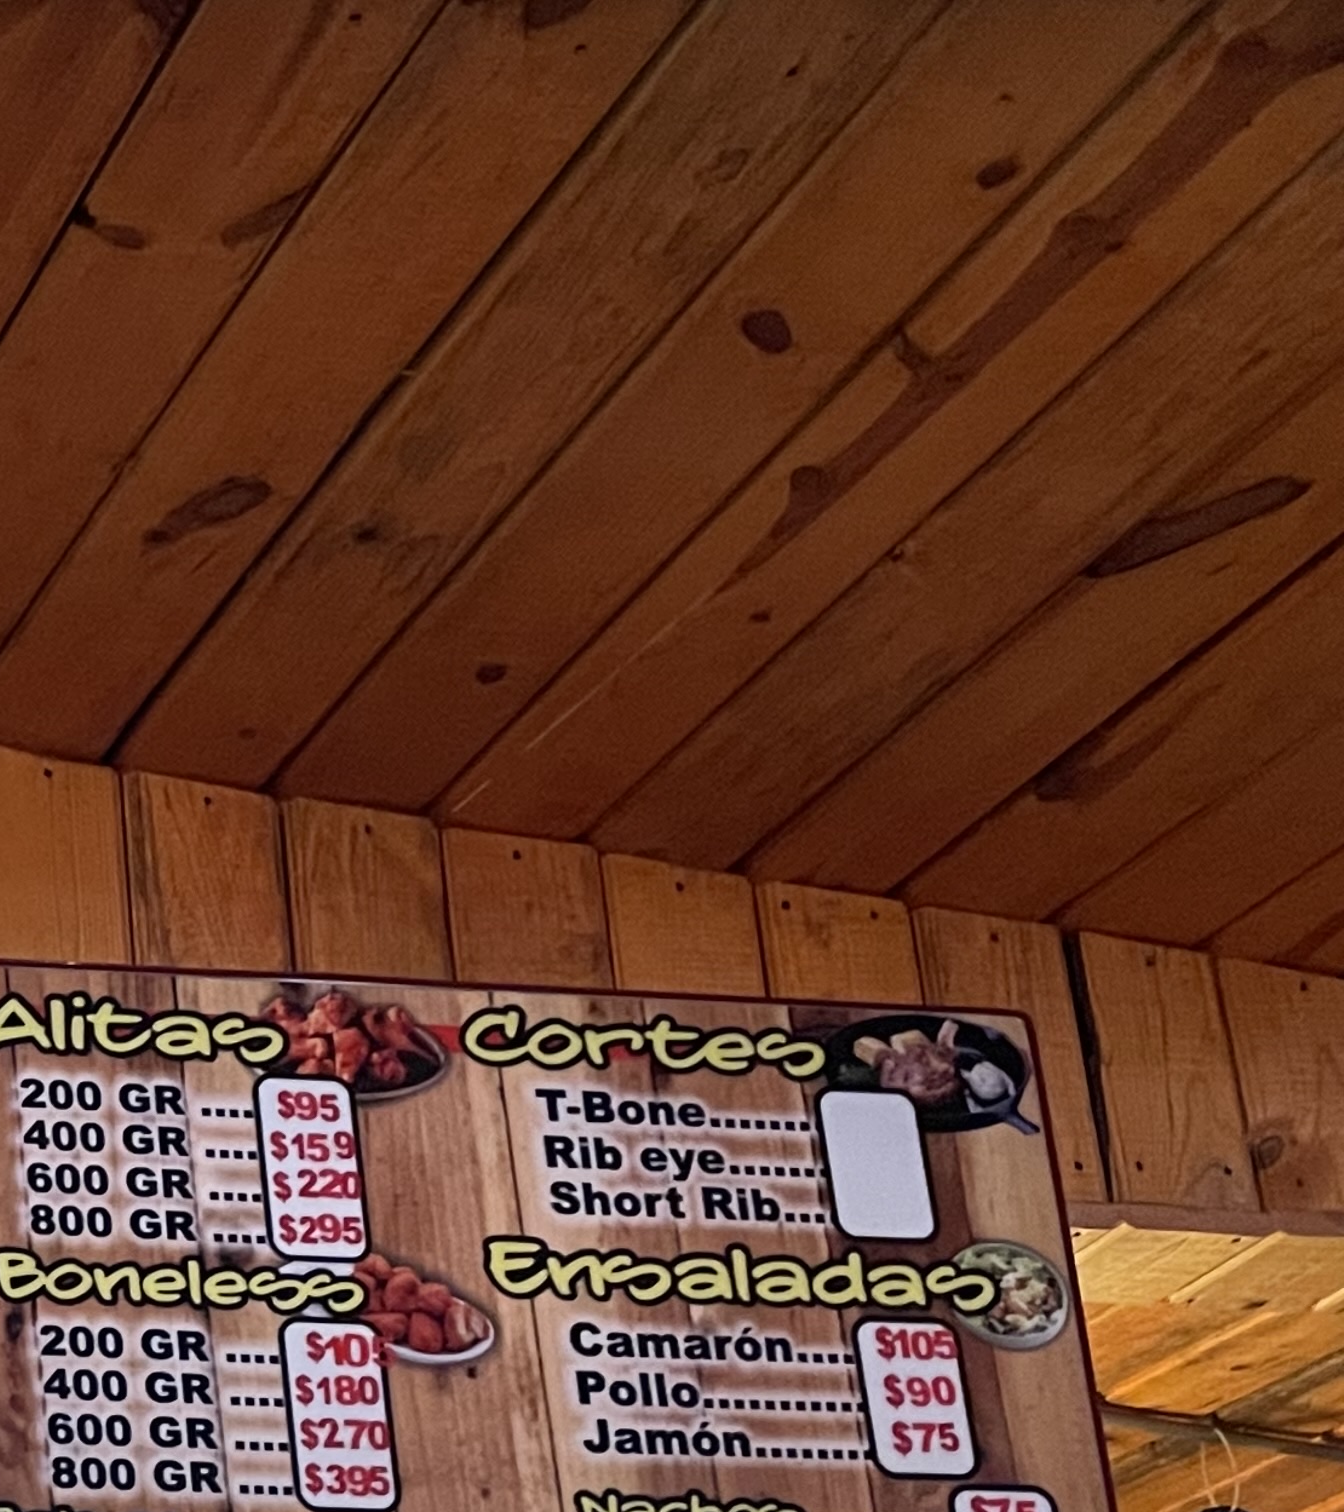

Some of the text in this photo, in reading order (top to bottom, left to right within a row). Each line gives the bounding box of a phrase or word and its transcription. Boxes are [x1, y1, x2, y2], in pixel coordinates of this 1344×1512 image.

[462, 1009, 828, 1079] Cortes
[20, 1078, 340, 1122] 200 GR $95
[23, 1119, 357, 1163] 400 GR $159
[543, 1134, 623, 1171] Rib
[550, 1181, 686, 1219] Short
[486, 1238, 997, 1314] Ensaladas
[40, 1324, 399, 1370] 200 GR $105
[875, 1327, 958, 1361] $105
[884, 1375, 957, 1407] $90
[45, 1412, 390, 1451] 600 GR $270
[892, 1422, 959, 1454] $75
